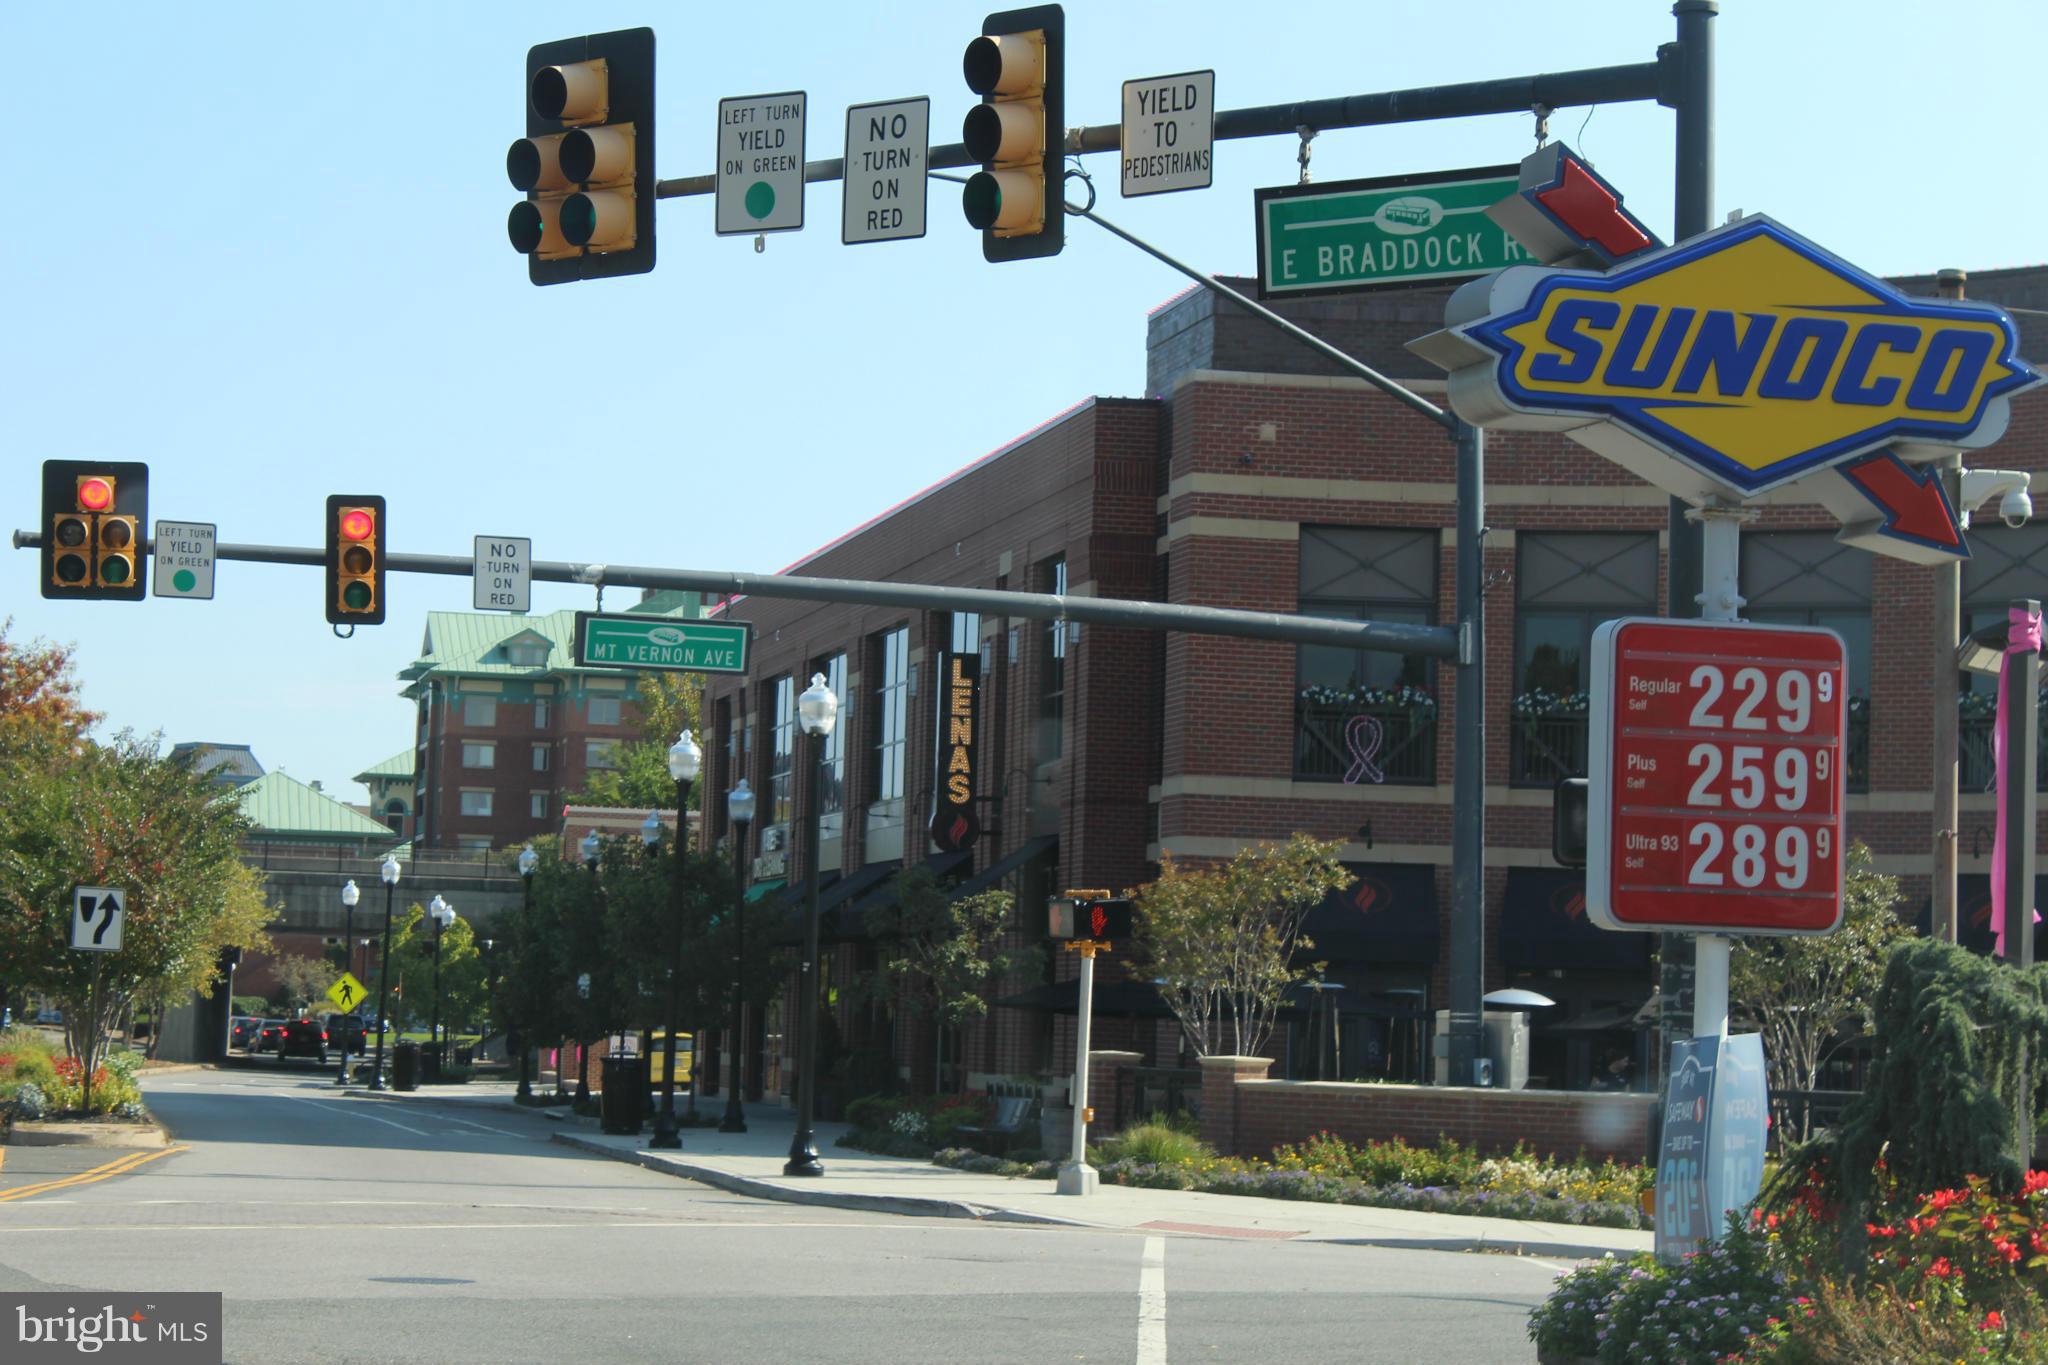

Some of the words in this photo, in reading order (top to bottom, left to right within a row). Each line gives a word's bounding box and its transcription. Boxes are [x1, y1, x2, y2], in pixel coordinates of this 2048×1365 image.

[1137, 84, 1198, 117] YIELD
[725, 107, 755, 126] LEFT
[765, 103, 800, 122] TURN
[869, 114, 907, 142] NO
[1154, 121, 1178, 148] TO
[738, 128, 786, 152] YIELD
[725, 159, 744, 176] ON
[753, 155, 797, 173] GREEN
[863, 148, 911, 173] TURN
[1124, 150, 1210, 180] PEDESTRIANS
[872, 179, 899, 201] ON
[867, 208, 903, 231] RED
[1283, 248, 1298, 280] E
[1318, 232, 1484, 277] BRADDOCK
[1503, 231, 1534, 261] R
[1528, 298, 1996, 413] SUNOCO
[159, 528, 183, 537] LEFT
[190, 528, 213, 539] TURN
[170, 541, 202, 554] YIELD
[490, 543, 517, 559] NO
[160, 555, 174, 565] ON
[178, 557, 210, 567] GREEN
[486, 561, 520, 574] TURN
[494, 577, 512, 590] ON
[490, 593, 516, 606] RED
[594, 643, 617, 660] MT
[627, 645, 696, 665] VERNON
[703, 649, 735, 666] AVE
[1628, 698, 1648, 711] Self
[1629, 675, 1682, 696] Regular
[1688, 665, 1812, 733] 229
[948, 658, 973, 805] LENAS
[1627, 754, 1657, 772] Plus
[1687, 743, 1809, 811] 259
[1627, 777, 1646, 790] Self
[1625, 856, 1645, 869] Self
[1626, 833, 1658, 851] Ultra
[1660, 834, 1680, 852] 93
[1687, 822, 1810, 890] 289
